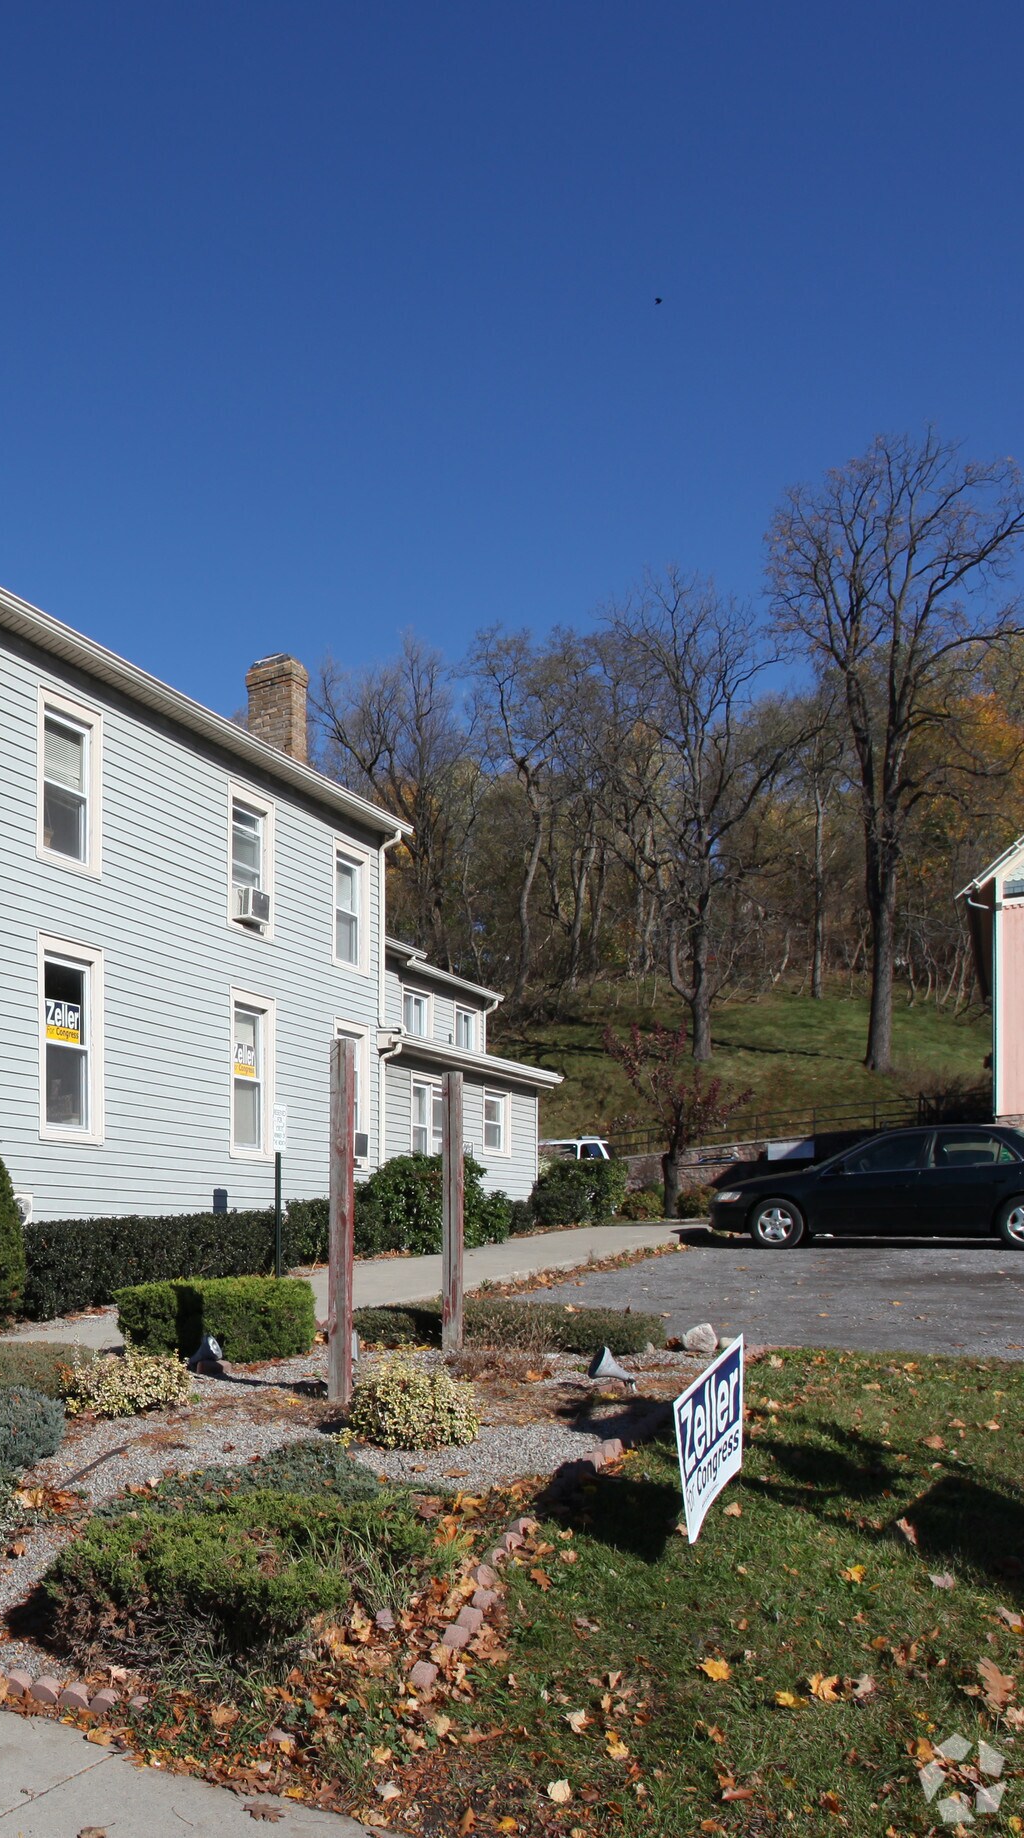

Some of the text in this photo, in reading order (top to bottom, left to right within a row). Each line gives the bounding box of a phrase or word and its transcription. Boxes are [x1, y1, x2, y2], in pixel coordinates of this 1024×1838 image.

[46, 1001, 79, 1030] Zeller
[47, 1026, 79, 1039] For Congress
[234, 1043, 255, 1066] Zeller
[238, 1063, 255, 1074] Congress
[680, 1367, 739, 1478] Zeller
[696, 1428, 739, 1496] Congress
